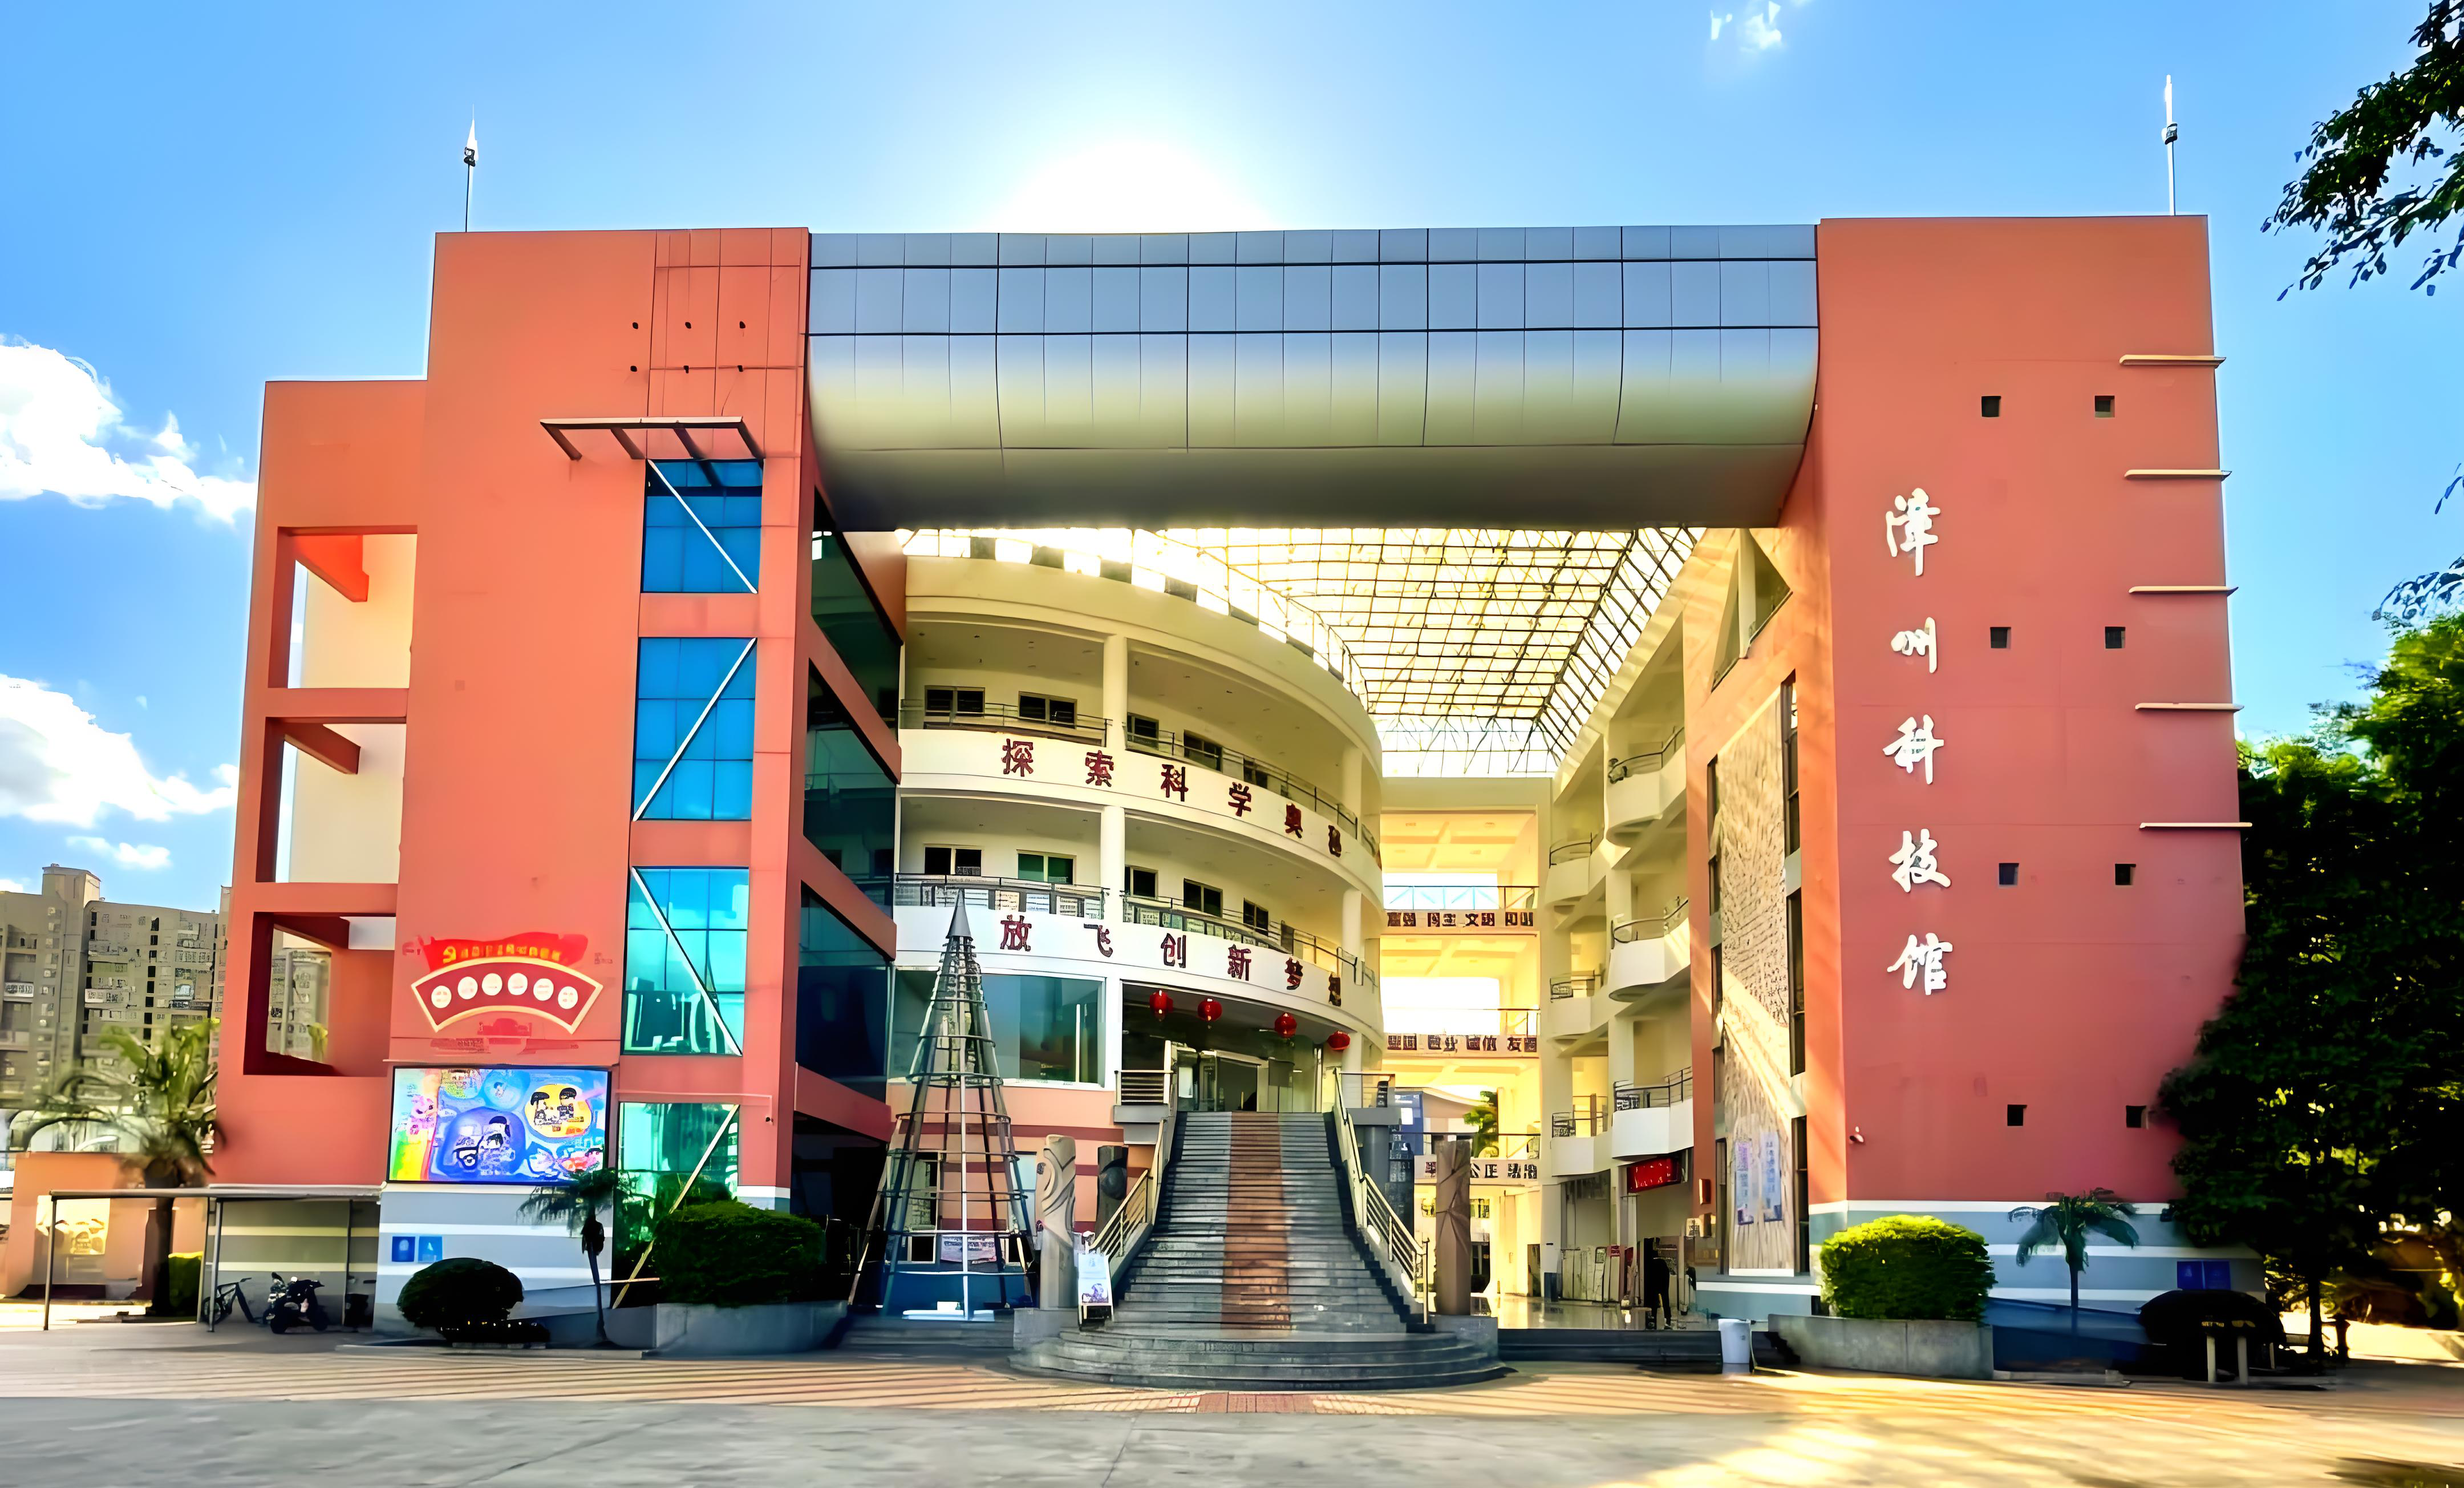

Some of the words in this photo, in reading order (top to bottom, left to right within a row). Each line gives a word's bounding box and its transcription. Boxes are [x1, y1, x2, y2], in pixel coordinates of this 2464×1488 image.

[1882, 488, 1953, 996] 漳州科技馆
